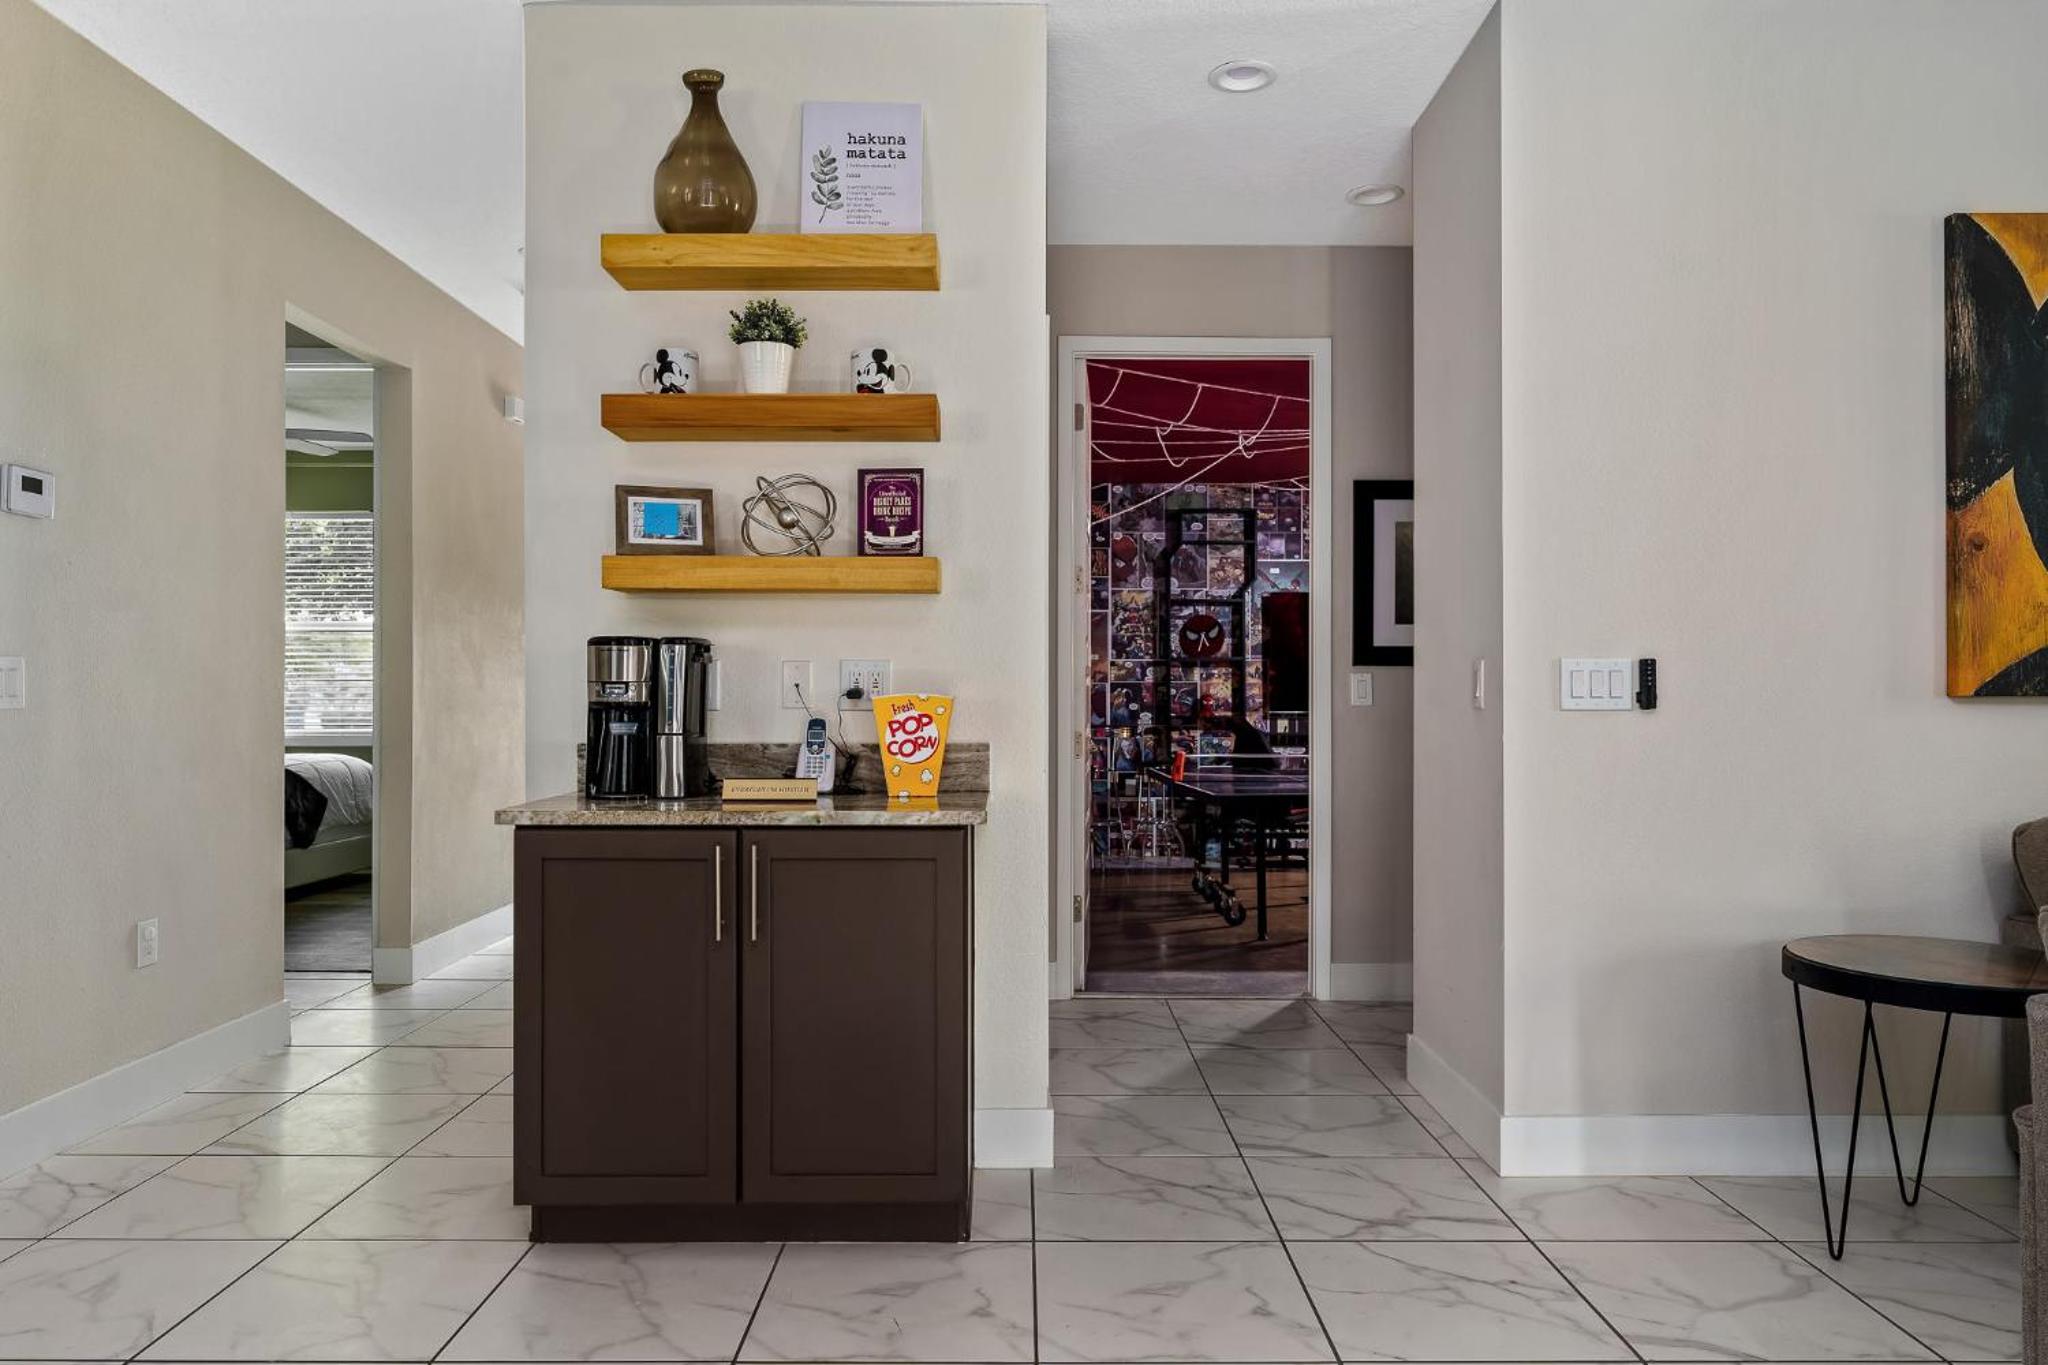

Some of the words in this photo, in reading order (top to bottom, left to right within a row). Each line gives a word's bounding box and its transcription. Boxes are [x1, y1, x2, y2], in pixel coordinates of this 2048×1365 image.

[847, 132, 906, 145] hakuna
[846, 148, 906, 159] matata
[887, 713, 934, 738] POP
[887, 736, 938, 758] CORN
